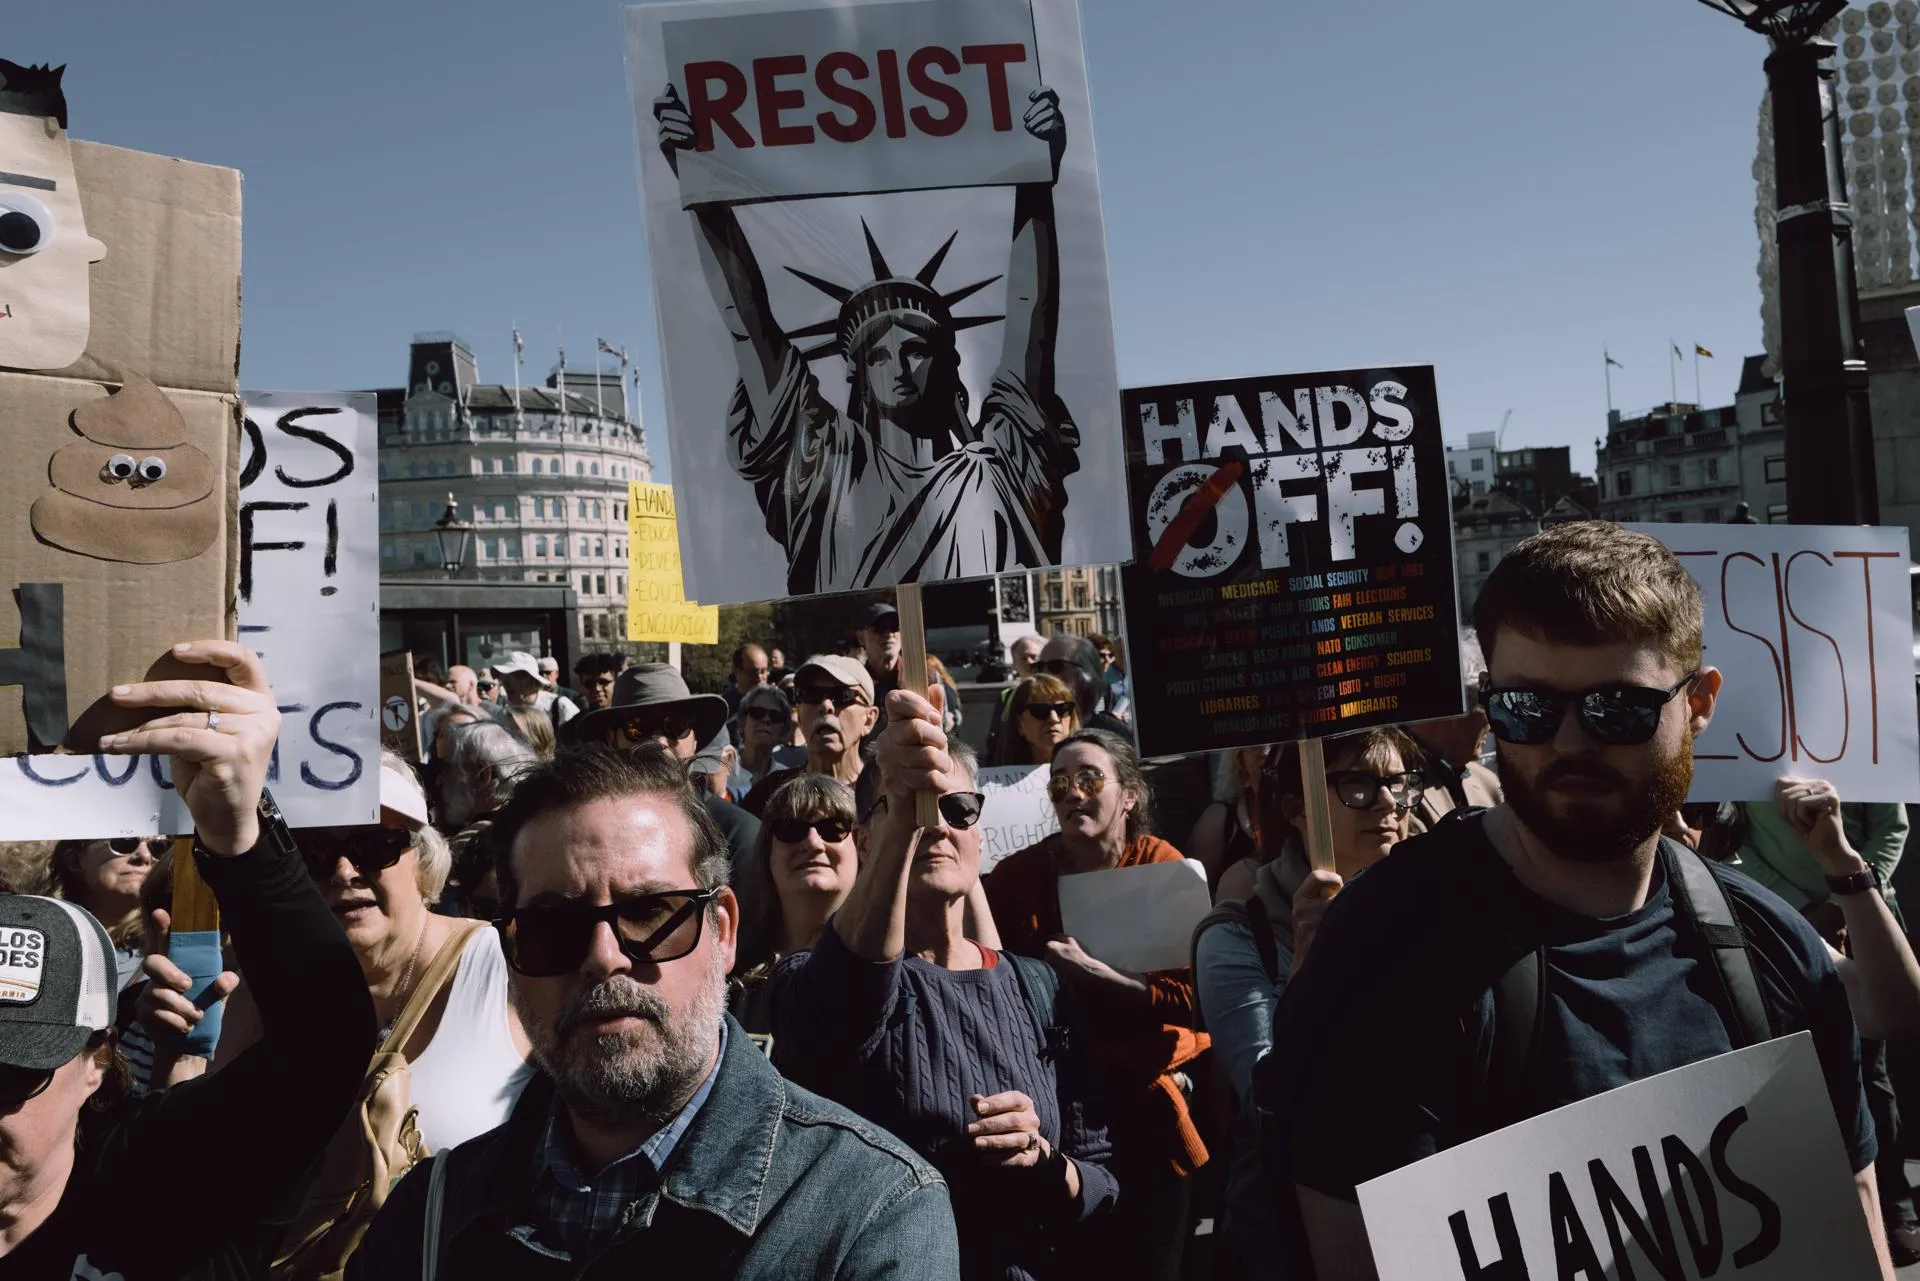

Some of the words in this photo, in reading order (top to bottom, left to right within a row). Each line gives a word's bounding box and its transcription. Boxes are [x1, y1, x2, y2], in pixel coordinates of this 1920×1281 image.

[684, 43, 1026, 152] RESIST
[1140, 381, 1415, 466] HANDS
[1146, 445, 1425, 577] OFF!
[1221, 578, 1280, 600] MEDICARE
[1288, 574, 1324, 593] SOCIAL
[1327, 568, 1369, 588] SECURITY
[1332, 591, 1353, 609] FAIR
[1356, 586, 1407, 606] ELECTIONS
[1261, 621, 1301, 642] PUBLIC
[1305, 616, 1336, 635] LANDS
[1340, 610, 1383, 631] VETERAN
[1388, 604, 1435, 624] SERVICES
[1316, 637, 1342, 656] NATO
[1344, 631, 1398, 652] CONSUMER
[1316, 660, 1344, 679] CLEAN
[1346, 654, 1380, 673] ENERGY
[1386, 647, 1432, 667] SCHOOLS
[1673, 550, 1901, 765] SIST
[1199, 694, 1261, 716] LIBRARIES
[1373, 671, 1407, 690] RIGHTS
[1340, 695, 1399, 719] IMMIGRANTS
[1447, 1105, 1782, 1281] HANDS
